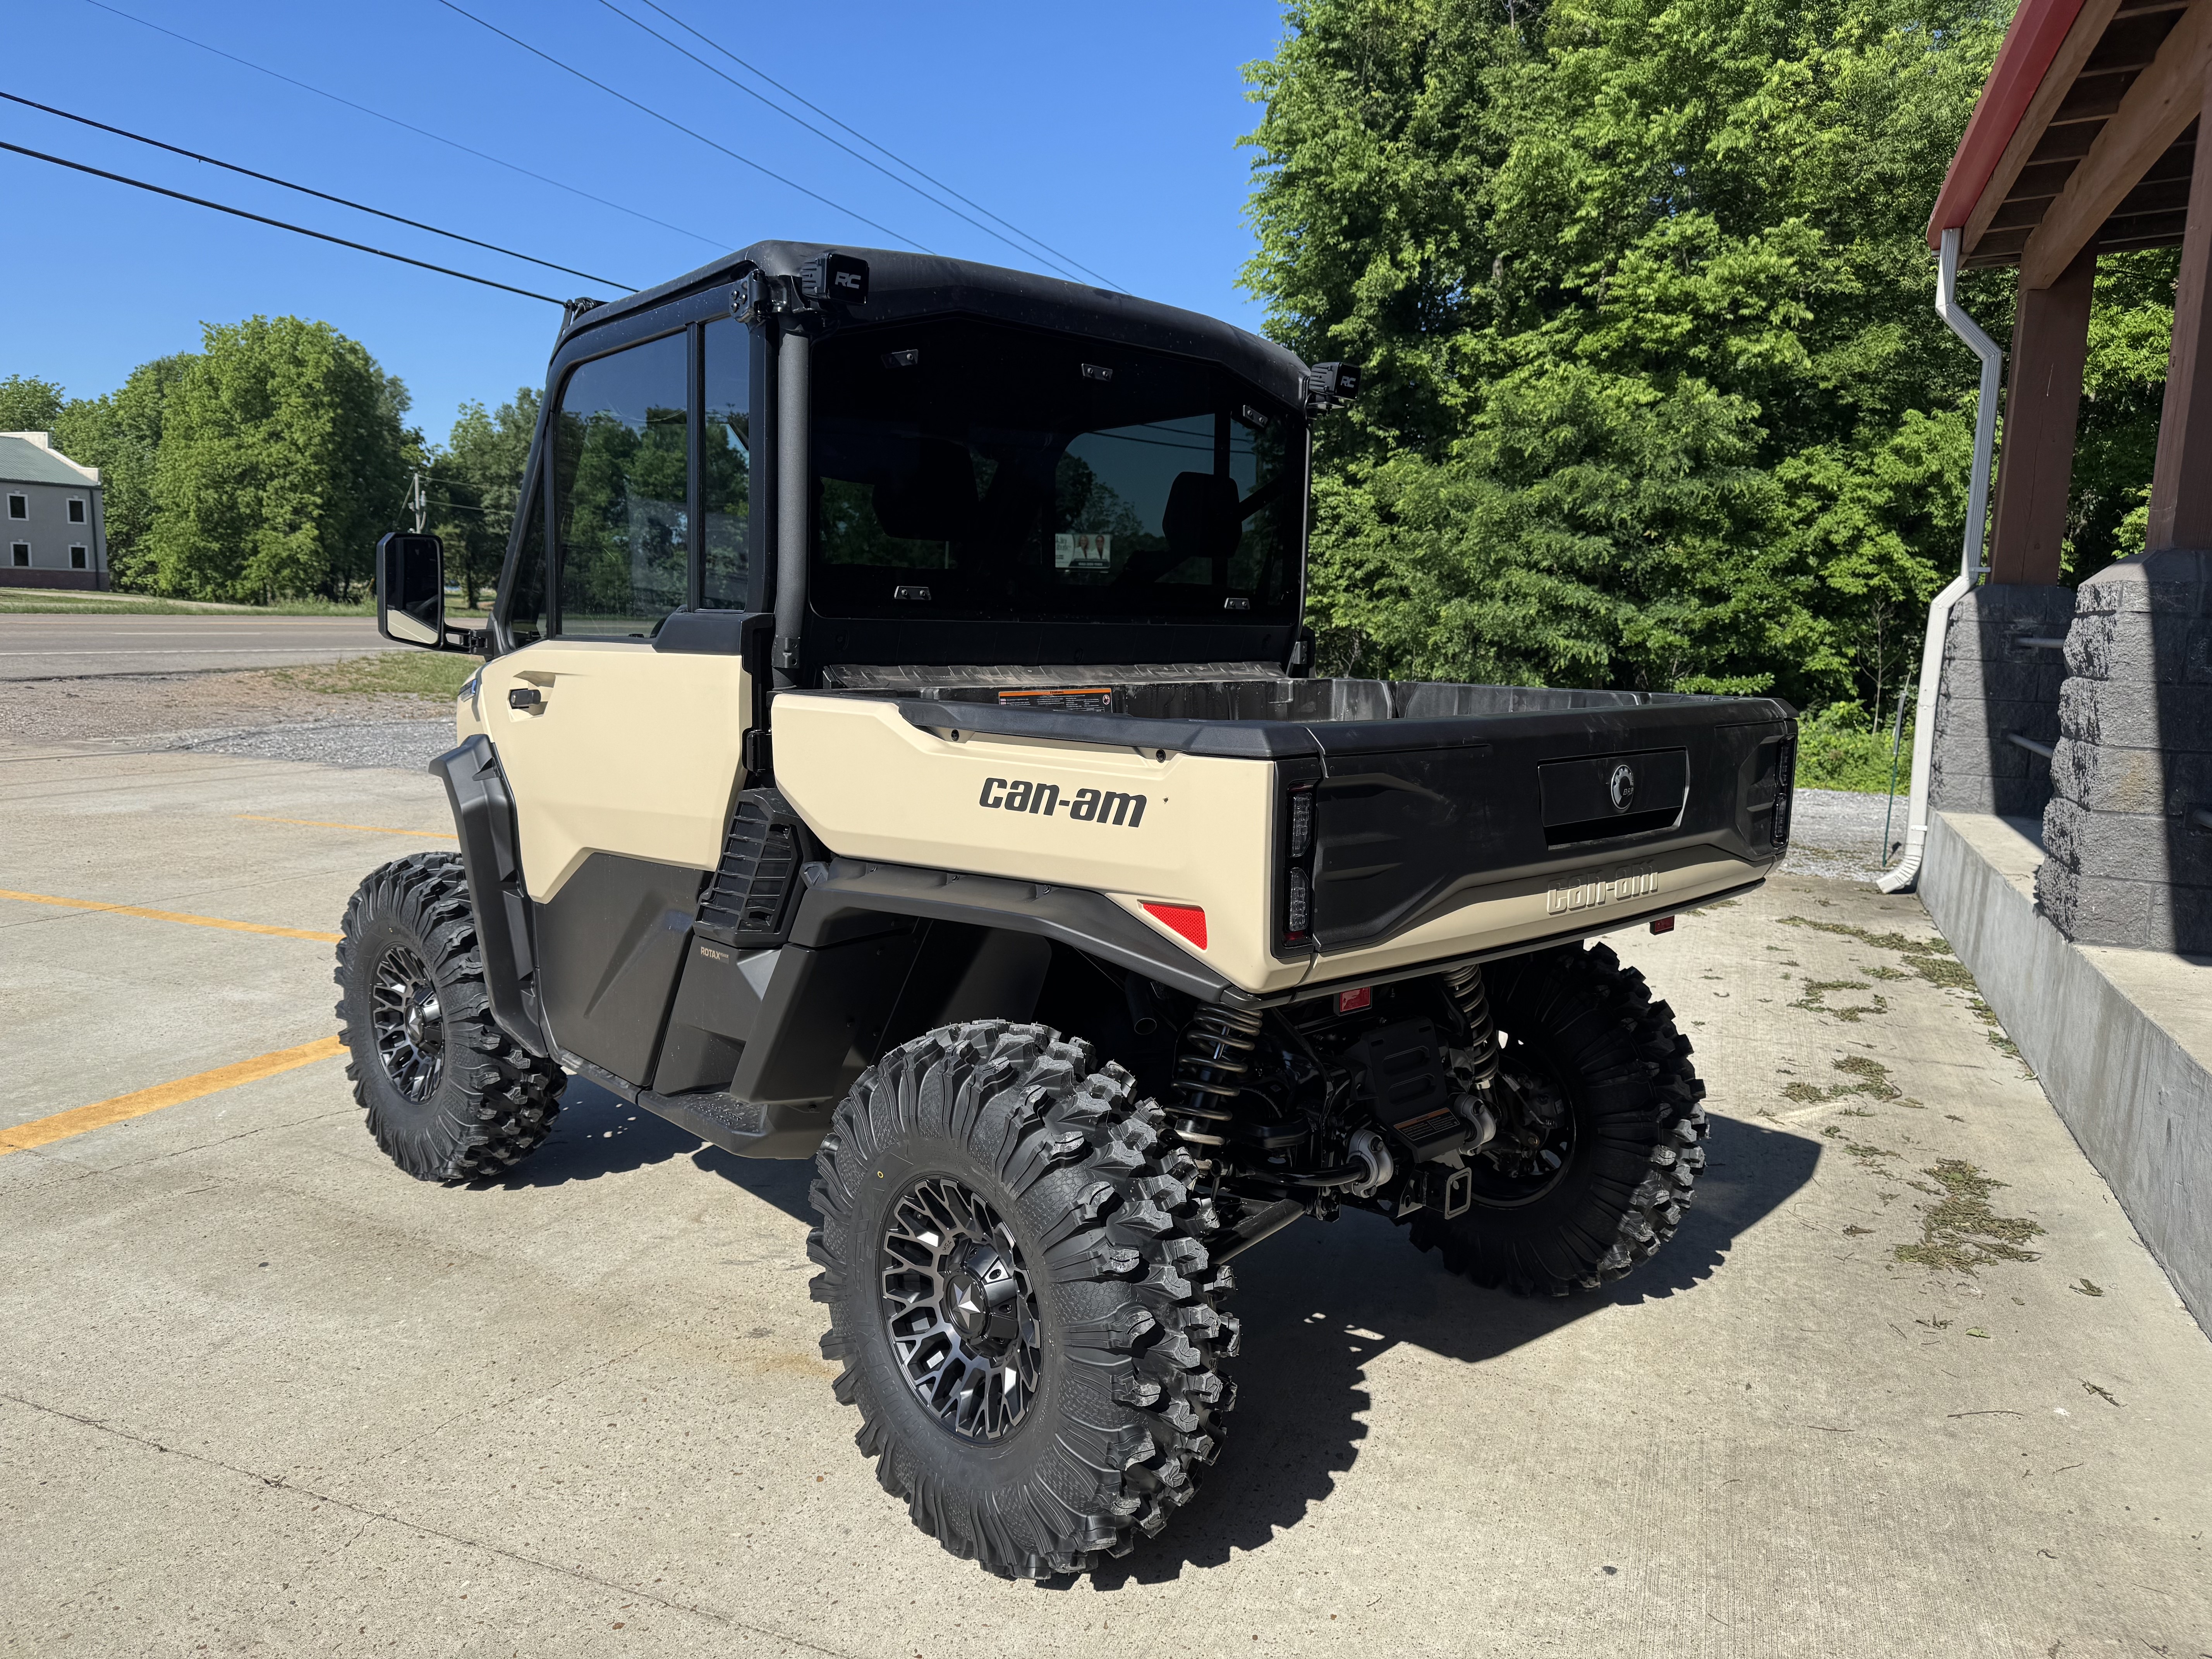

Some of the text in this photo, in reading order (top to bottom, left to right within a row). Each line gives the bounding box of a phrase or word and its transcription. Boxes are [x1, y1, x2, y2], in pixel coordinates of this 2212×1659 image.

[835, 271, 861, 289] RC
[1340, 376, 1356, 388] RC
[1623, 787, 1633, 796] BRP
[979, 778, 1147, 828] can-am
[1547, 859, 1658, 914] can-am
[701, 946, 720, 960] ROTAX
